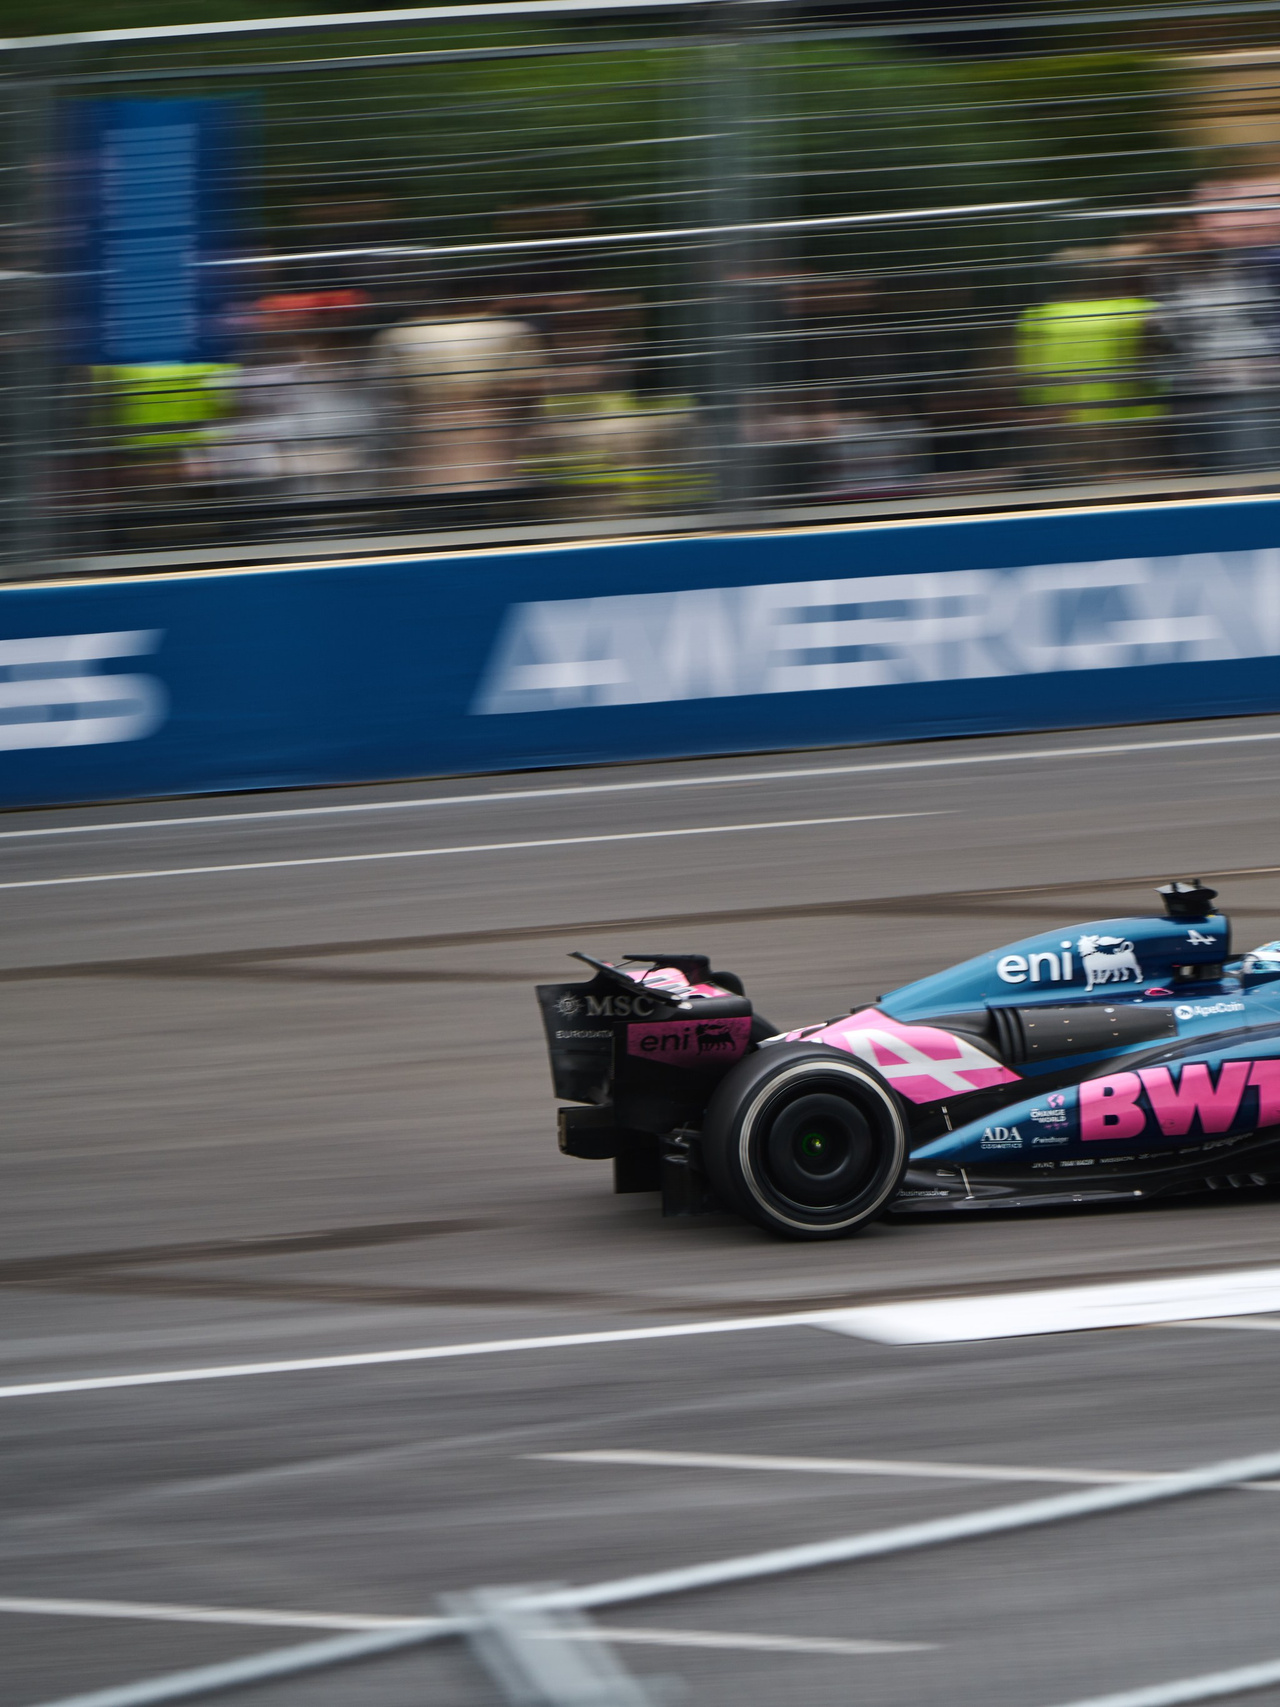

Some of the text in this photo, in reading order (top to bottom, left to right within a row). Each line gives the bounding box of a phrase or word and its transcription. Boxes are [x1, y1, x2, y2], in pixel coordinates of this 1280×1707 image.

[996, 940, 1073, 983] eni
[583, 994, 656, 1017] MSC
[640, 1027, 692, 1052] eni
[980, 1127, 1023, 1142] ADA
